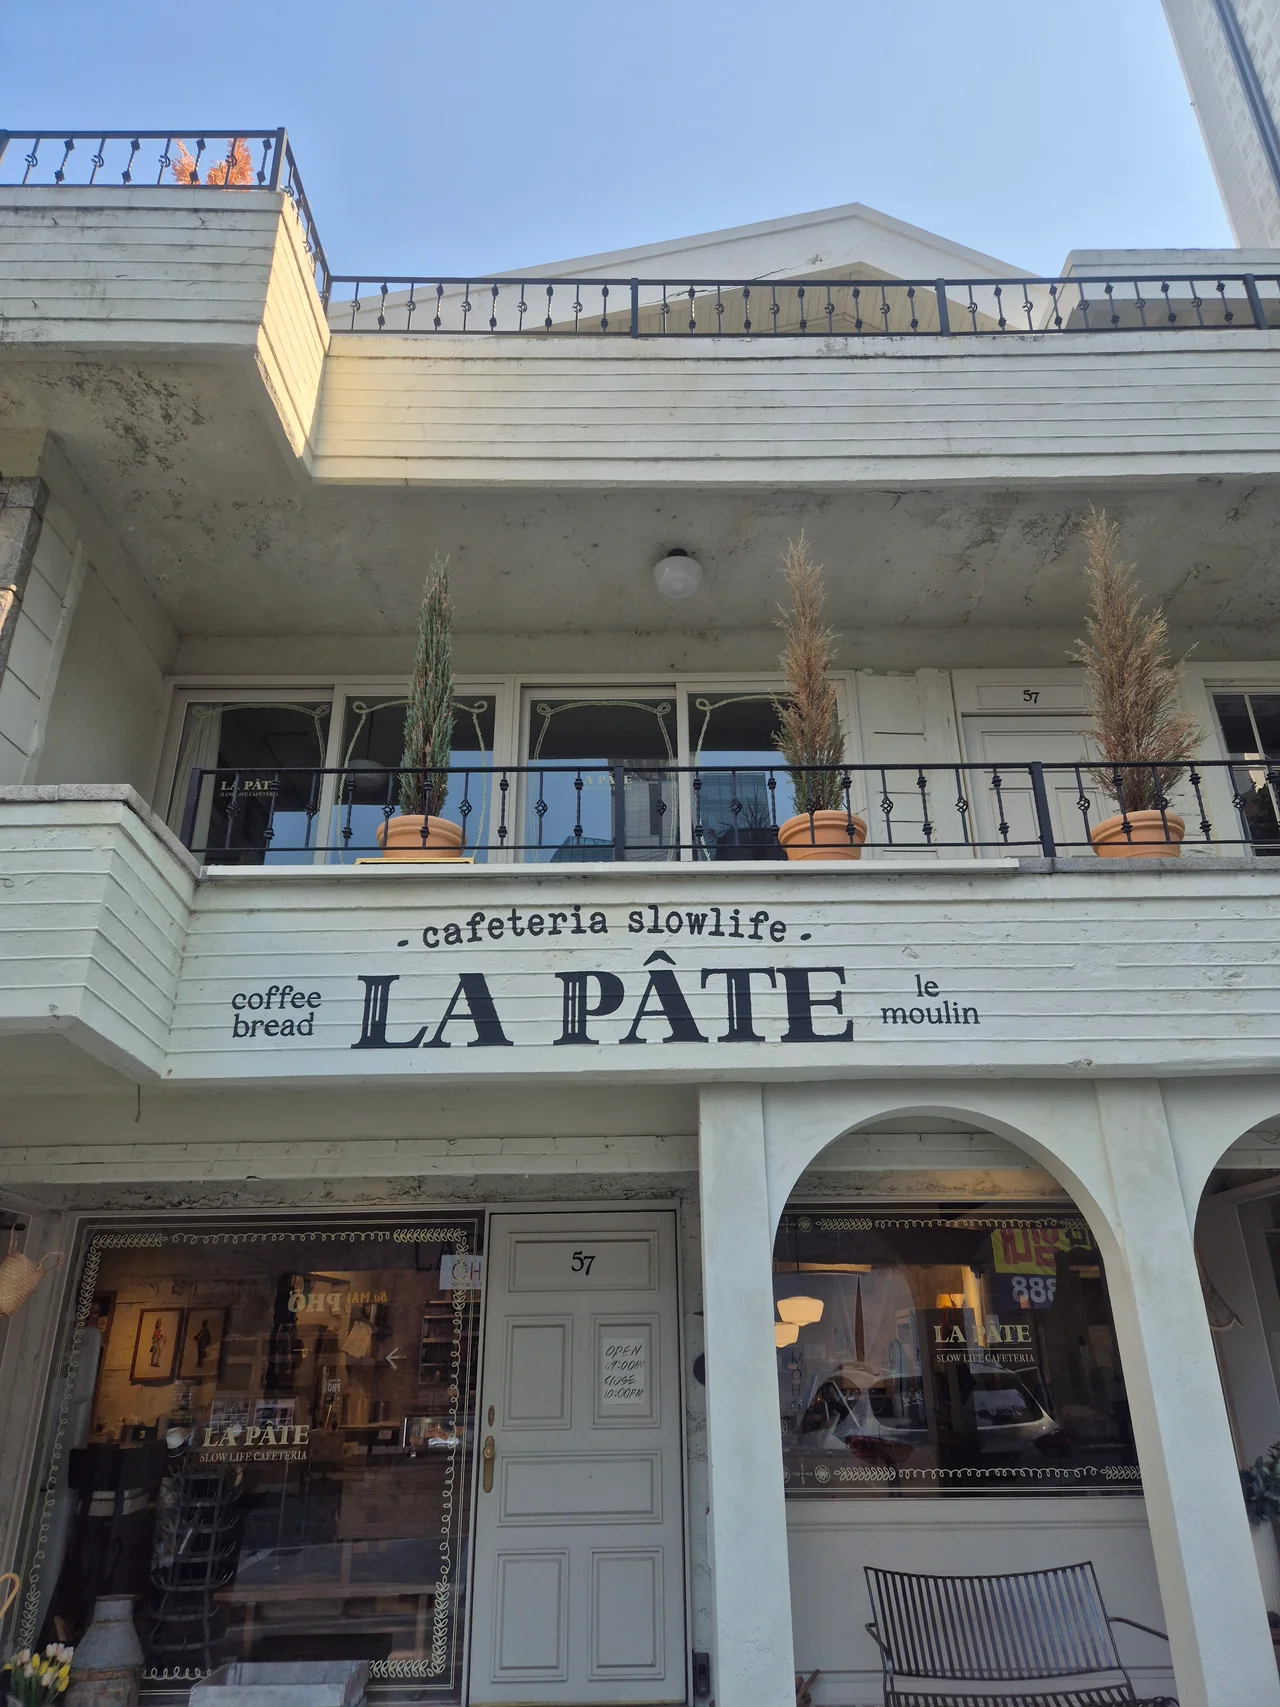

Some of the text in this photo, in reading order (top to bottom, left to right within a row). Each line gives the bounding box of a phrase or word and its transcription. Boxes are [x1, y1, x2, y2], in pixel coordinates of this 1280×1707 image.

[1023, 689, 1040, 704] 57
[422, 905, 788, 949] cafeteria slowlife
[231, 985, 322, 1010] coffee
[915, 973, 940, 998] le
[350, 950, 854, 1049] LA PÂTE
[232, 1012, 314, 1038] bread
[880, 1000, 981, 1025] moulin
[571, 1250, 597, 1276] 57
[933, 1325, 966, 1343] LA
[605, 1344, 643, 1359] OPEN
[936, 1353, 1035, 1363] SLOW LIFE CAFETERIA
[202, 1420, 310, 1447] LA PÂTE
[200, 1450, 308, 1462] SLOW LIFE CAFETERIA
